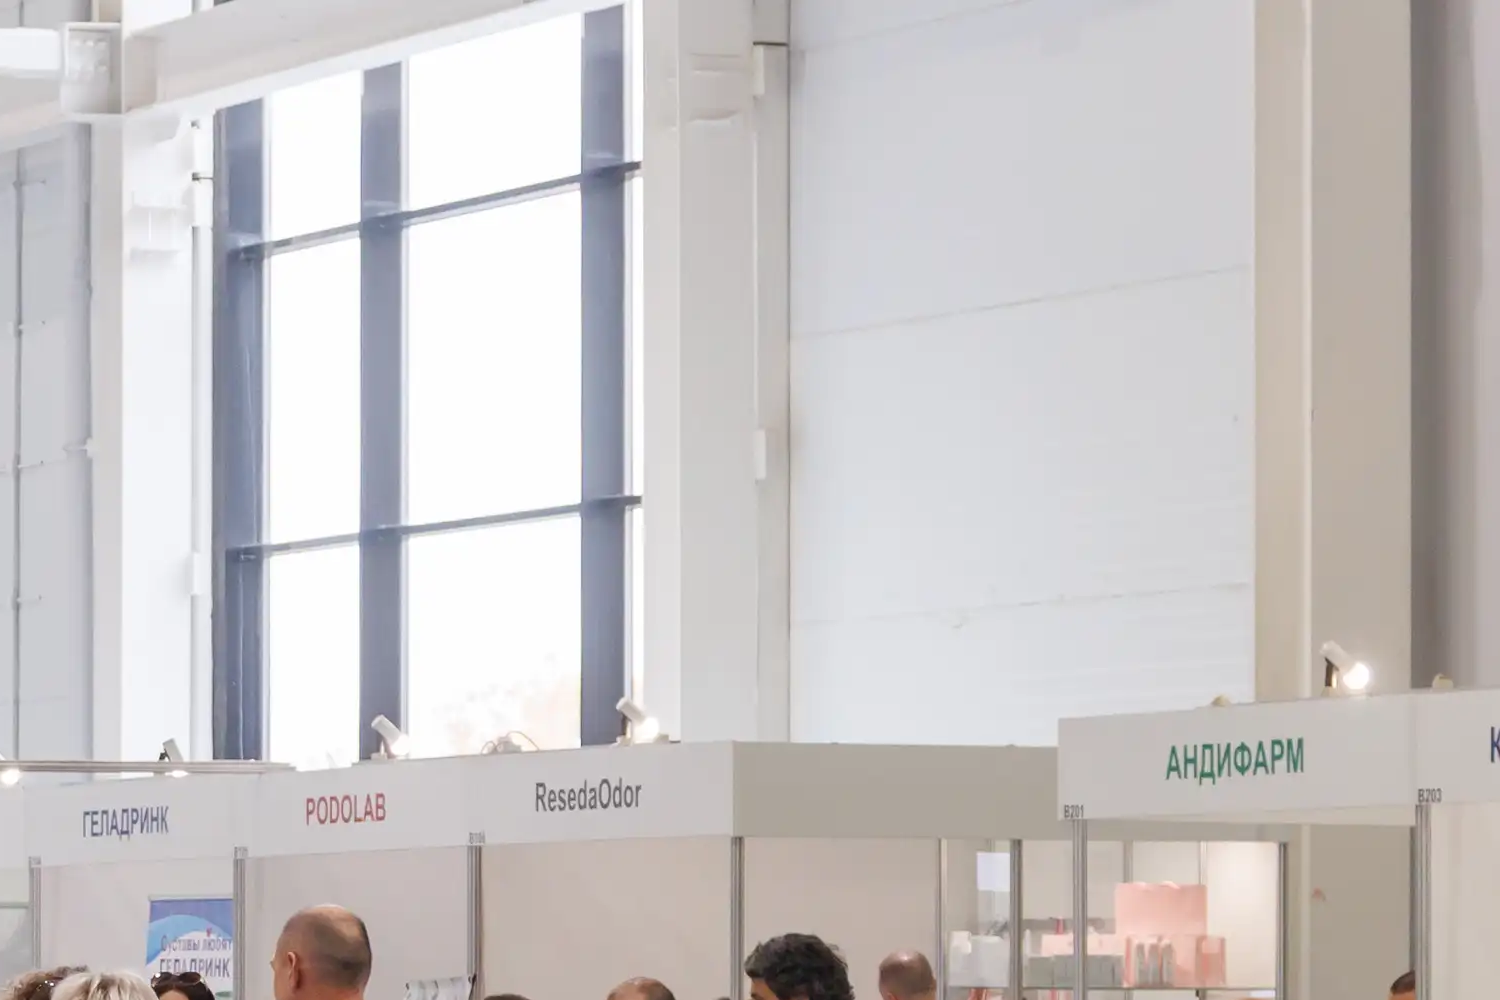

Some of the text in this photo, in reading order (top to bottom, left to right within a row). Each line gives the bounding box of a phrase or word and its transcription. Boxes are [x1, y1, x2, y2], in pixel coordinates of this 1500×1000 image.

[1165, 737, 1305, 785] АНДИФАРМ
[306, 793, 387, 826] PODOLAB
[535, 777, 642, 812] ResedaOdor
[1064, 804, 1084, 818] B201
[1418, 788, 1442, 803] B203
[82, 806, 169, 841] ГЕЛАДРИНК
